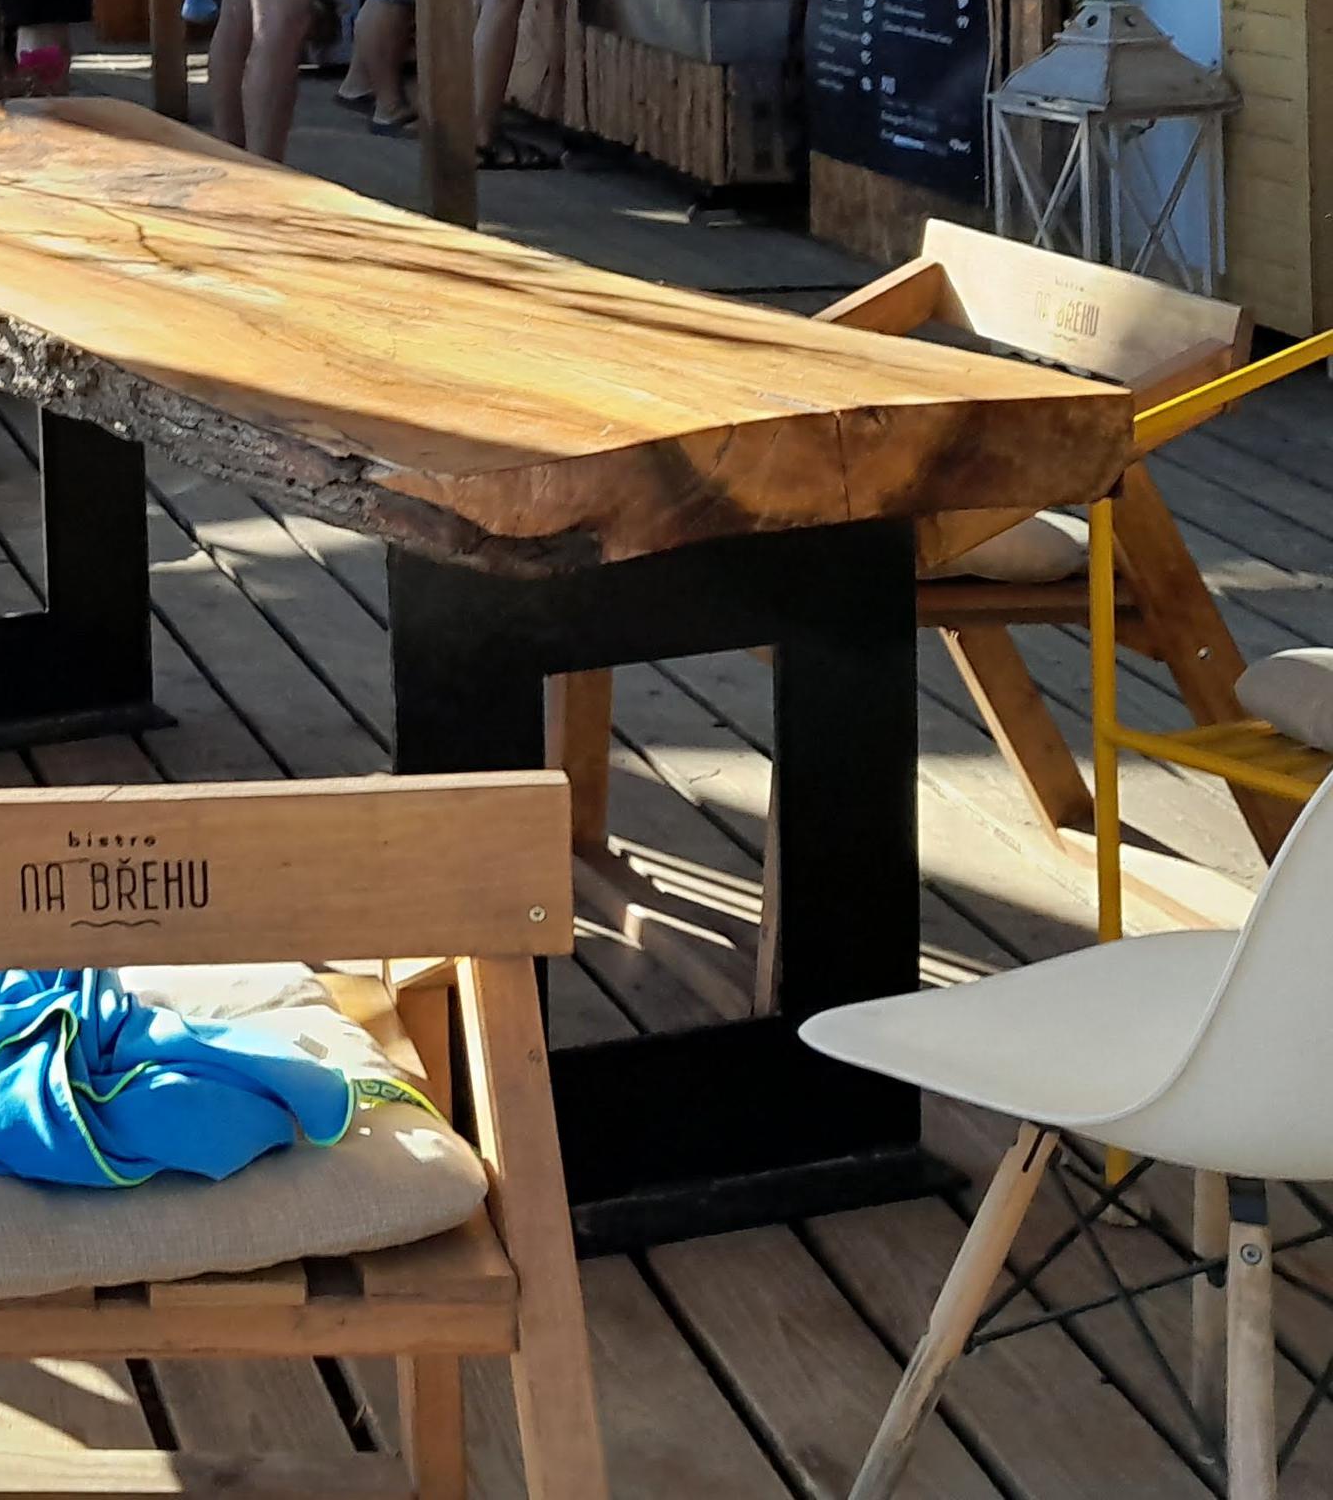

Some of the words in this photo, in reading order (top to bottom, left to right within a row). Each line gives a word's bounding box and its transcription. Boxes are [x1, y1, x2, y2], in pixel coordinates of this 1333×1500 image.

[68, 831, 157, 847] bistro
[21, 862, 65, 912] NA
[91, 857, 208, 910] BŘEHU
